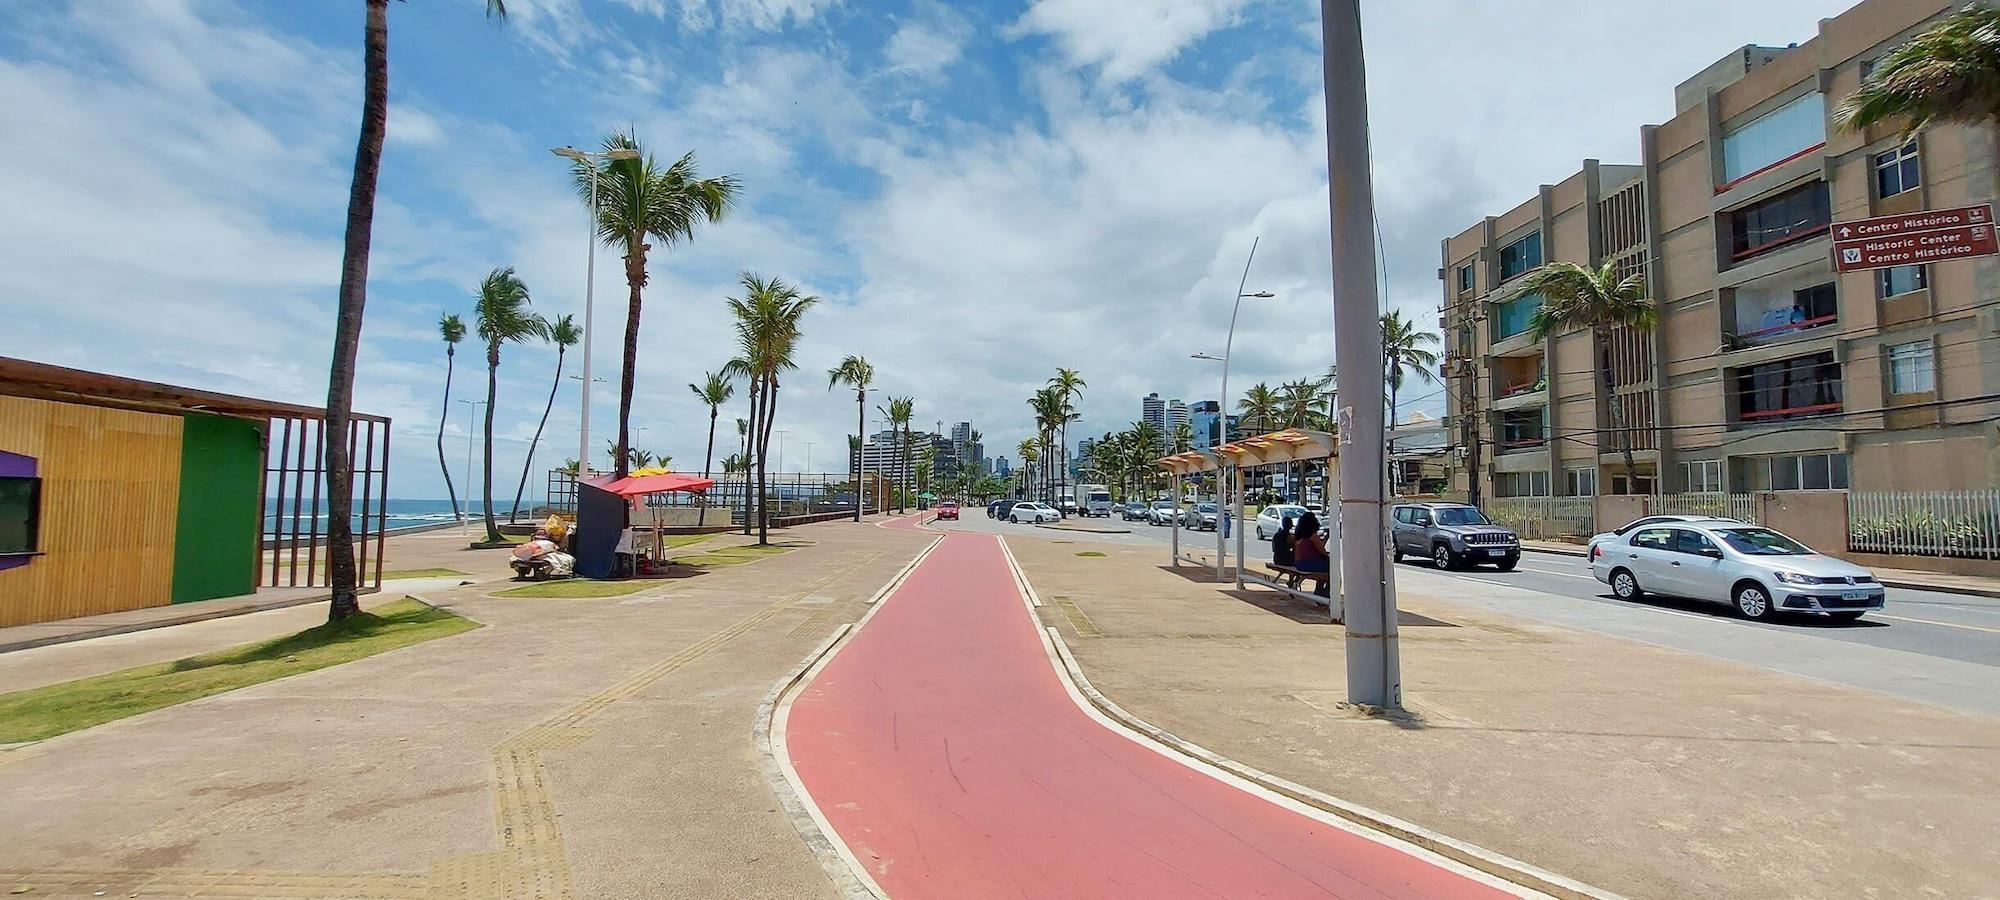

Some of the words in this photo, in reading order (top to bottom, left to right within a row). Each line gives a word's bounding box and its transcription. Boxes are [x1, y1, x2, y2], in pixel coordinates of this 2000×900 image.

[1858, 222, 1899, 233] Centro
[1904, 214, 1960, 228] Histórico
[1866, 239, 1915, 251] Historic
[1920, 233, 1961, 244] Center
[1868, 253, 1910, 263] Centro
[1915, 245, 1972, 258] Histórico
